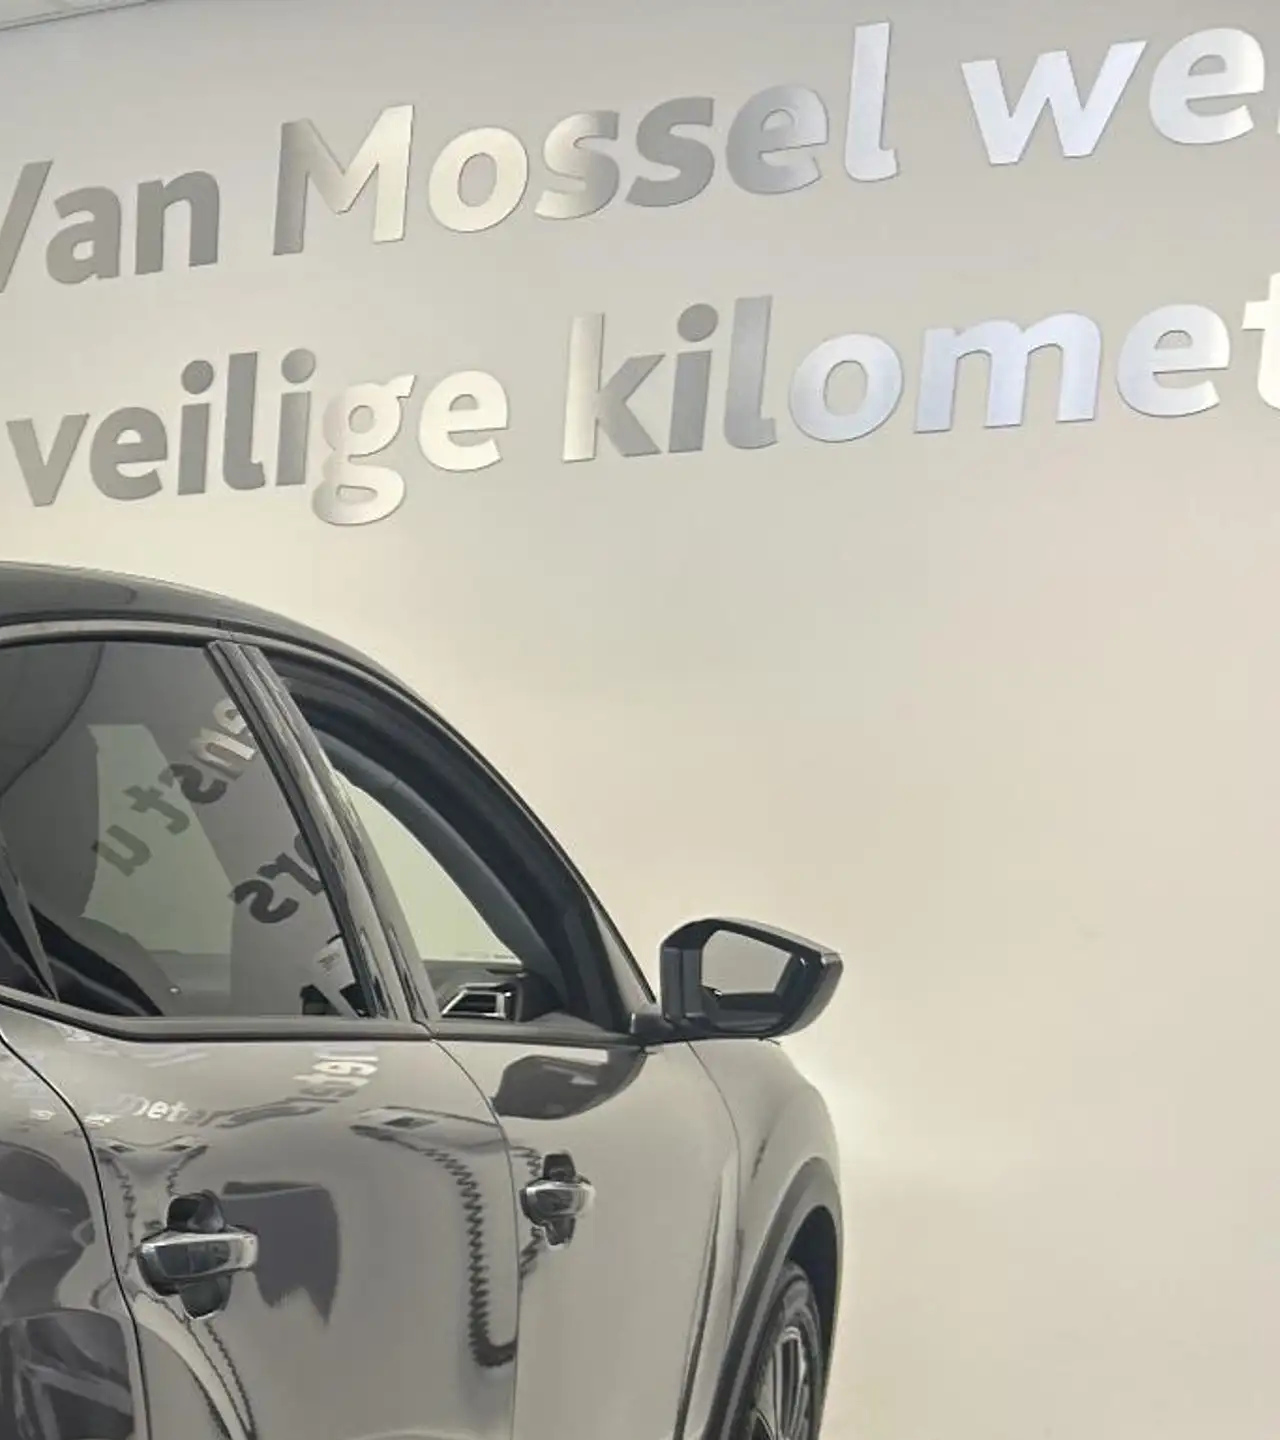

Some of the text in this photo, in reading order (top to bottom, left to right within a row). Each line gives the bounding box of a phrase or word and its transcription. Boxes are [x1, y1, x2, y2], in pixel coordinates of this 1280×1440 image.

[274, 21, 899, 258] Mossel
[960, 26, 1280, 167] we
[6, 347, 511, 527] veilige
